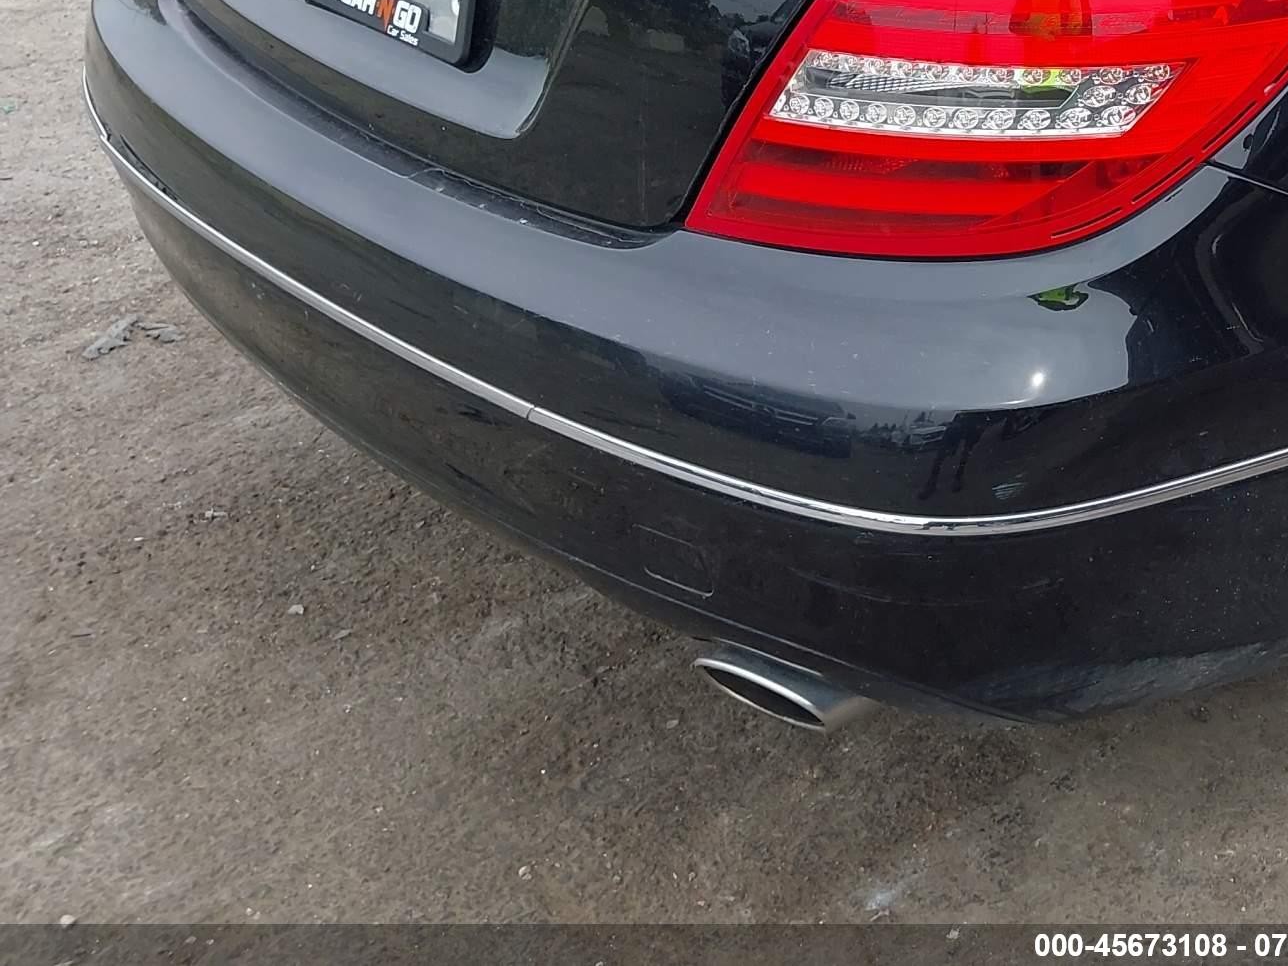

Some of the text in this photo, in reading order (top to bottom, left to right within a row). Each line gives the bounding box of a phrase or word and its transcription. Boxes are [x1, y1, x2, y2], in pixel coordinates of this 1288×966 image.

[393, 0, 422, 34] GO
[386, 24, 419, 47] Car Sales
